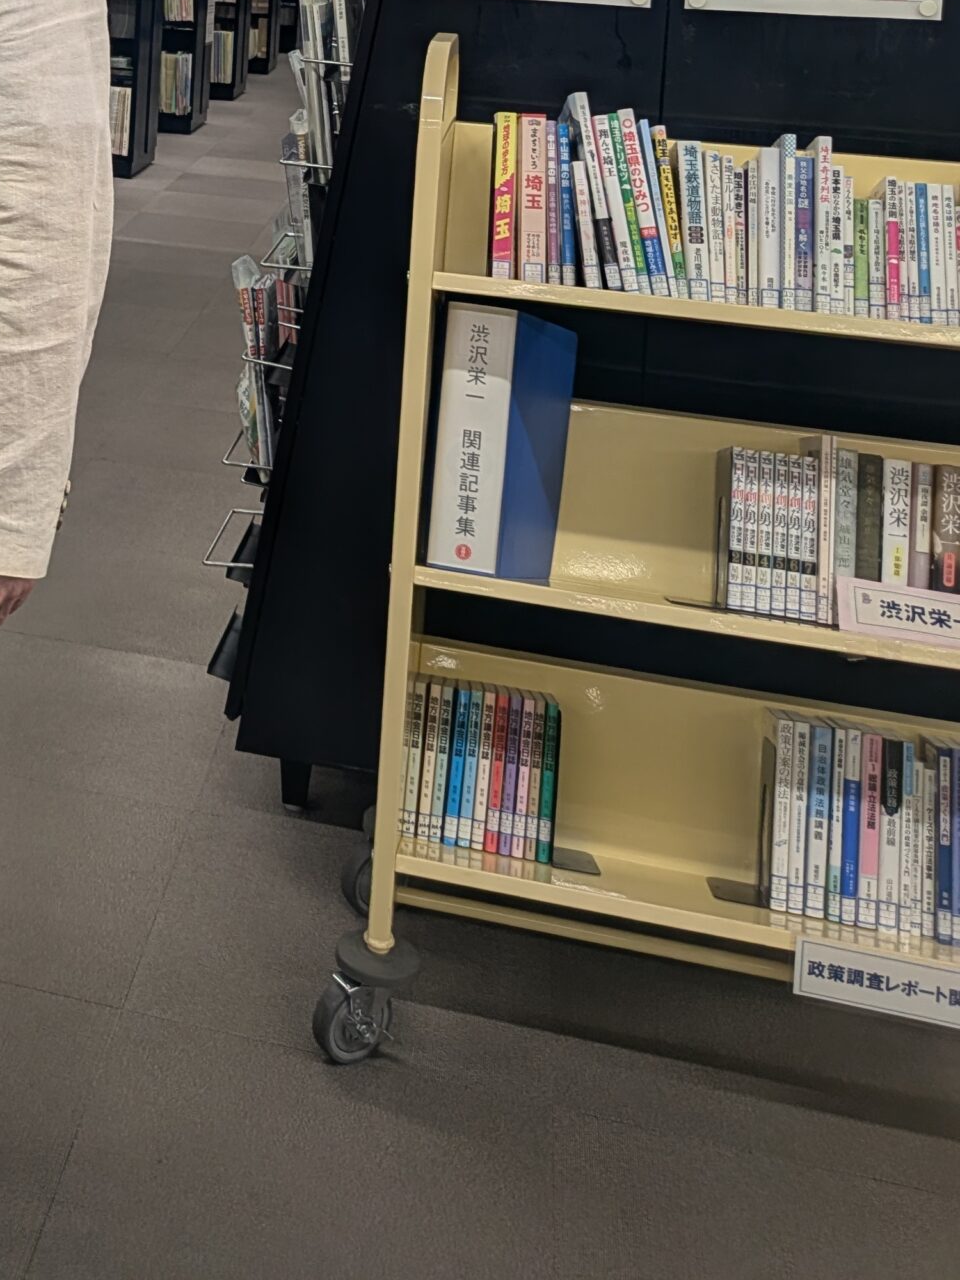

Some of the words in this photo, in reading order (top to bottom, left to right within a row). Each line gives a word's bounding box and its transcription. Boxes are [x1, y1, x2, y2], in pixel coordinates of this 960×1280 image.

[502, 124, 511, 176] 地球の歩き方
[598, 128, 616, 178] 翔んで埼玉
[610, 119, 628, 181] 埼玉のトリセツ
[623, 130, 650, 213] 埼玉県のひみつ
[524, 174, 544, 210] 埼玉
[683, 145, 702, 224] 埼玉鉄道物語
[710, 164, 722, 240] さいたま動物記
[724, 165, 734, 212] 埼玉ルール
[734, 172, 744, 218] 埼玉のおきて
[800, 161, 809, 208] 秩父の地名の謎
[832, 170, 842, 240] 日本史のなかの埼玉県
[888, 179, 897, 218] 埼玉の法則
[944, 196, 952, 228] 地名は語る
[495, 194, 510, 240] 埼玉
[465, 323, 490, 400] 渋沢栄一
[455, 428, 482, 538] 関連記事集
[886, 466, 910, 540] 渋沢栄一
[940, 472, 960, 546] 渋沢栄一
[731, 552, 740, 563] 2
[746, 552, 754, 564] 3
[760, 555, 769, 567] 4
[776, 556, 784, 569] 5
[790, 560, 798, 571] 6
[804, 562, 812, 574] 7
[410, 693, 424, 749] 地方議会日誌
[426, 696, 440, 752] 地方議会日誌
[438, 699, 452, 754] 地方議会日誌
[454, 702, 468, 758] 地方議会日誌
[468, 702, 480, 758] 地方議会日誌
[481, 704, 494, 760] 地方議会日誌
[494, 706, 506, 762] 地方議会日誌
[507, 708, 520, 764] 地方議会日誌
[520, 711, 532, 767] 地方議会日誌
[532, 712, 544, 769] 地方議会日誌
[544, 714, 556, 772] 地方議会日誌
[778, 723, 792, 800] 政策立案の技法
[814, 743, 828, 841] 自治体政策法務講義
[807, 960, 960, 1006] 政策調査レポート関
